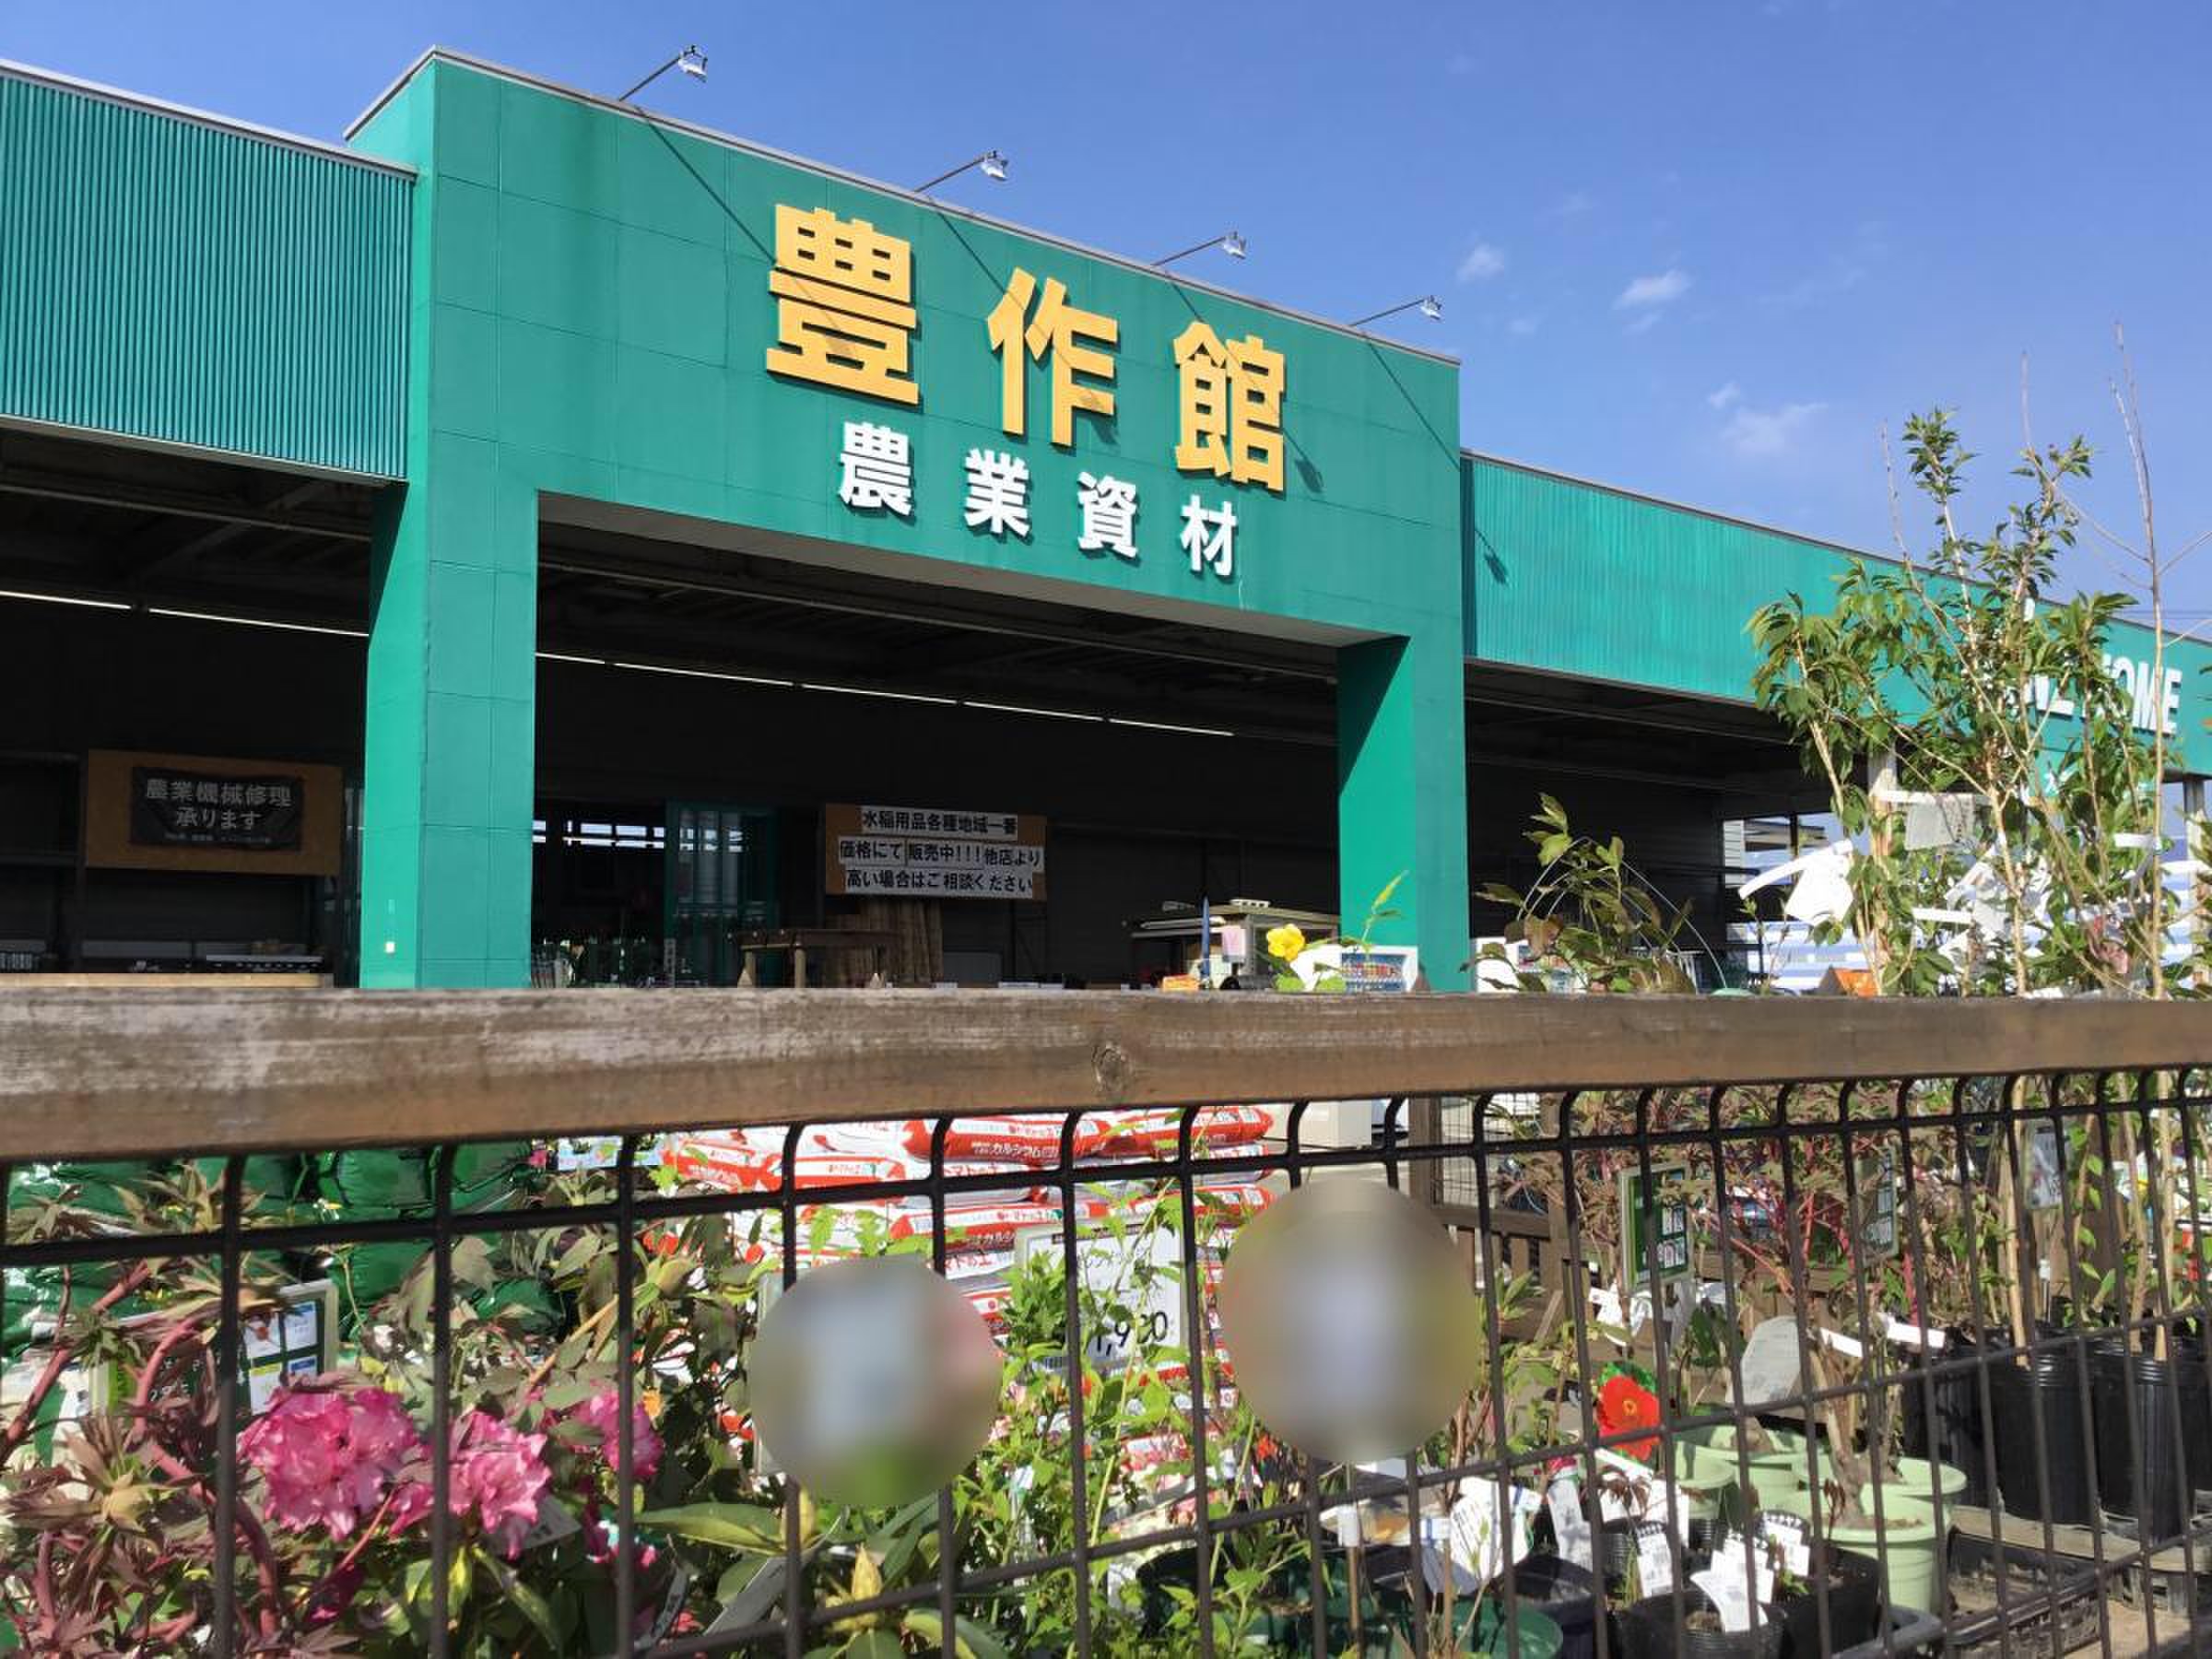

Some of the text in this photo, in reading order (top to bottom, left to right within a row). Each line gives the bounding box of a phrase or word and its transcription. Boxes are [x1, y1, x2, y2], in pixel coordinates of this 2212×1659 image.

[767, 204, 1285, 493] 豊作館
[837, 421, 1238, 576] 農業資材
[175, 806, 263, 830] 承ります
[863, 810, 1018, 835] 水稲用品各種地域一番
